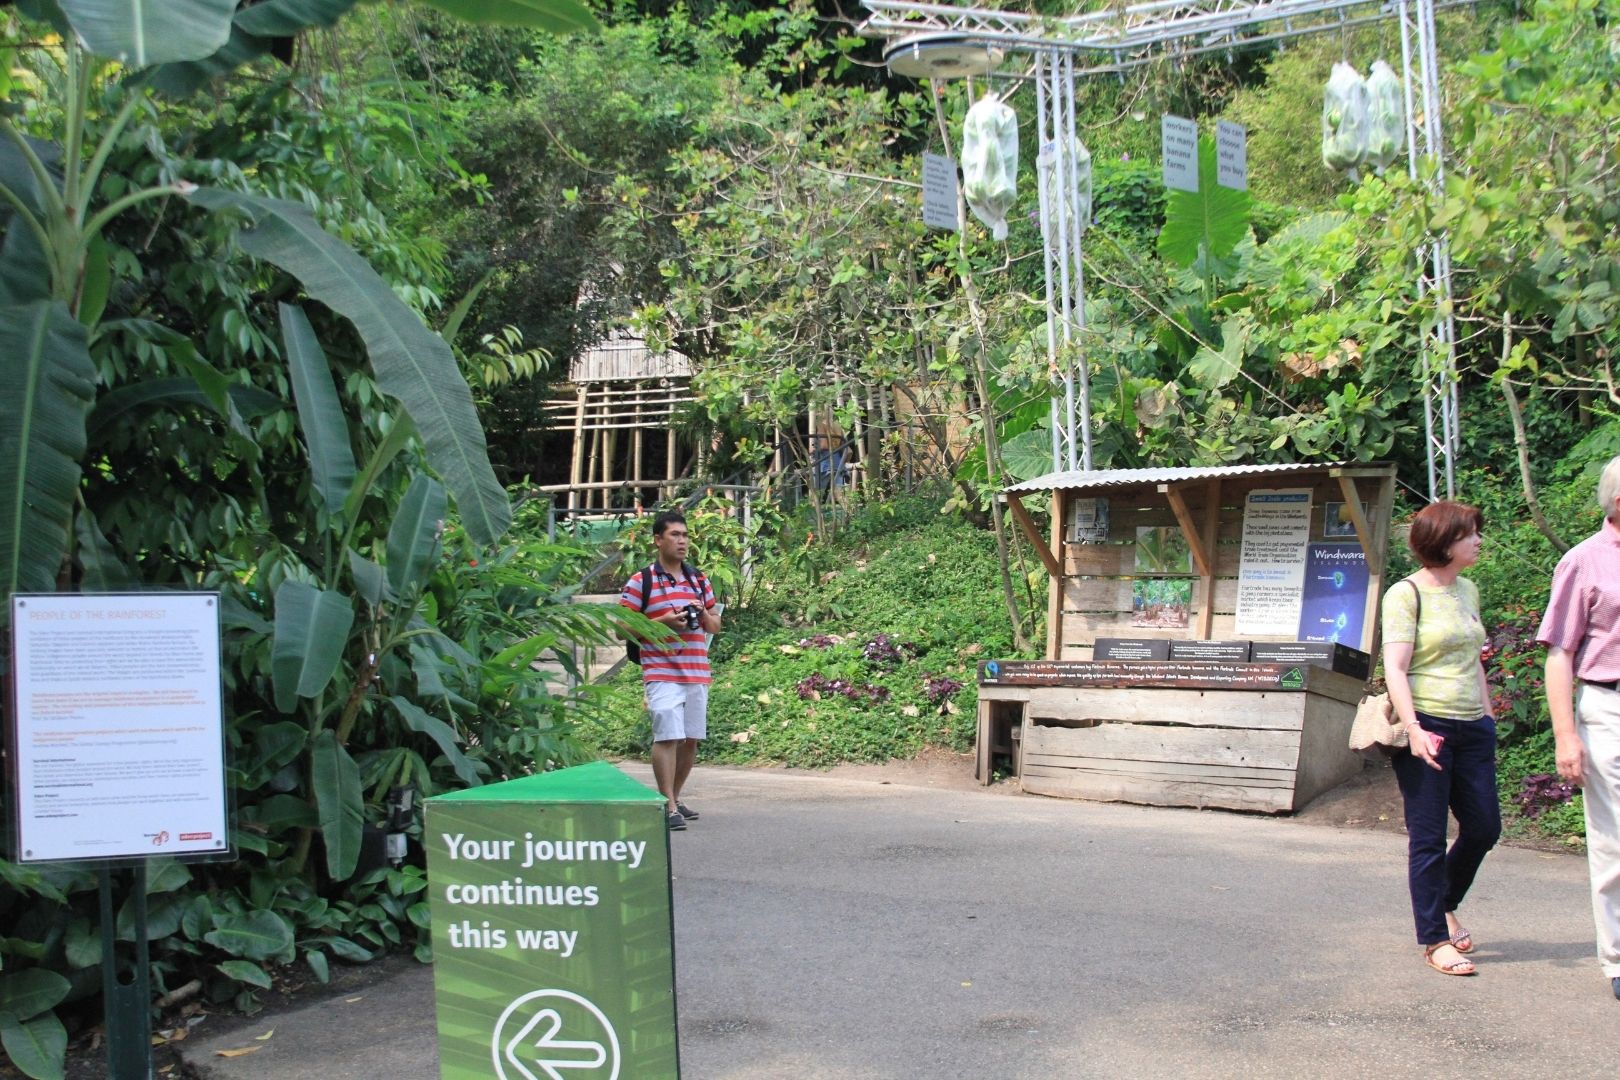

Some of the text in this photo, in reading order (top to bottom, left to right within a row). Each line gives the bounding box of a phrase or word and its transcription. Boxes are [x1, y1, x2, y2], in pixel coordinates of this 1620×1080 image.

[1166, 122, 1193, 134] workers
[1220, 125, 1243, 138] You can
[1176, 136, 1195, 150] many
[1220, 138, 1240, 149] choose
[1166, 146, 1191, 159] banana
[1220, 151, 1234, 160] what
[1166, 159, 1186, 171] farms
[1220, 164, 1244, 178] you buy
[30, 609, 166, 620] PEOPLE OF THE RAINFOREST
[442, 832, 646, 868] Your journey
[446, 877, 600, 906] continues
[448, 920, 578, 958] this way
